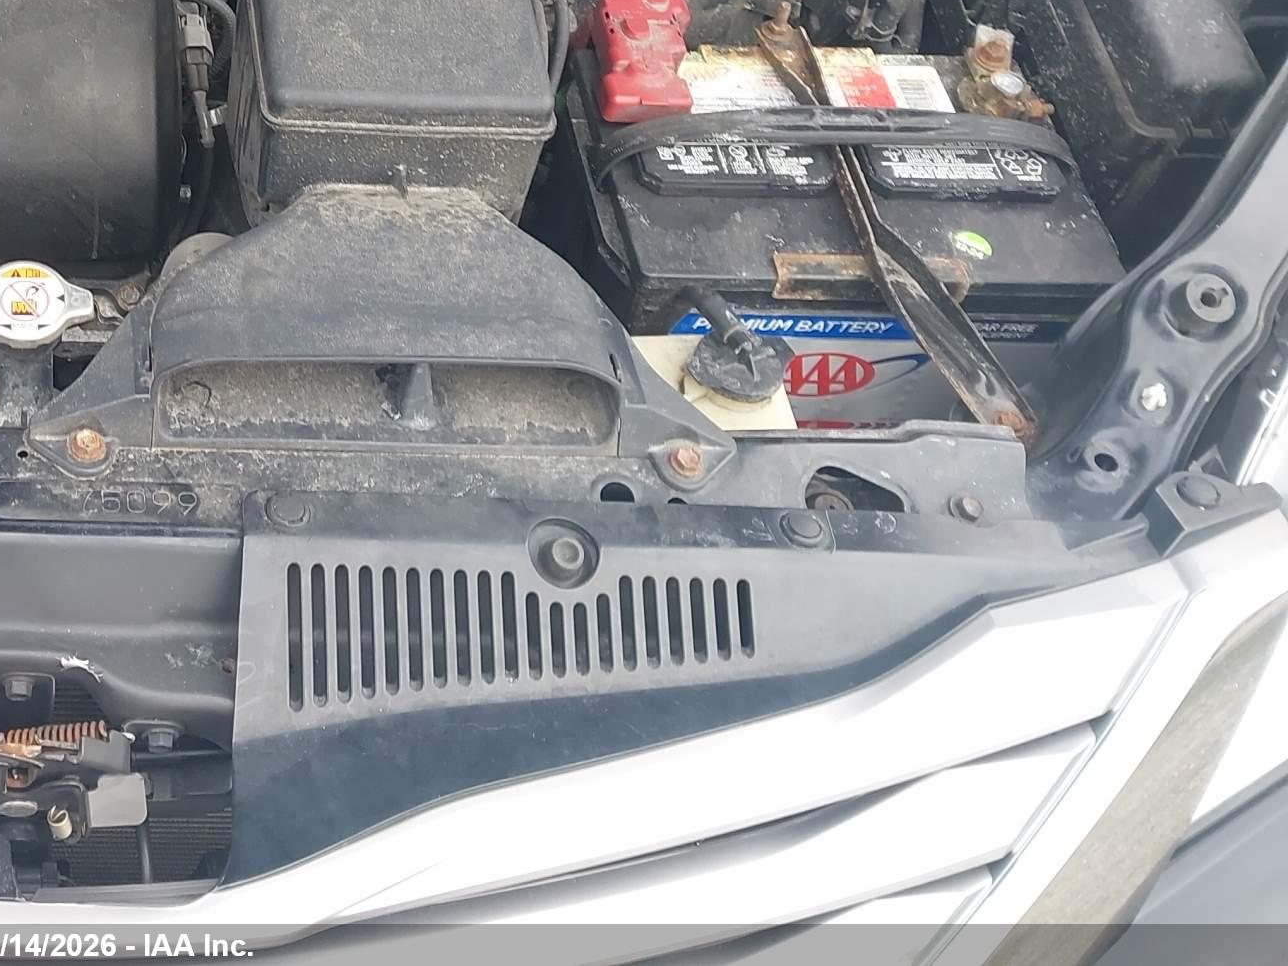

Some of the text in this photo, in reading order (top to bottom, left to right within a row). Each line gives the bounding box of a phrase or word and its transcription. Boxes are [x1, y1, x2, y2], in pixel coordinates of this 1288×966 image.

[692, 317, 895, 334] PMIUM BATTERY
[784, 353, 862, 396] AAA
